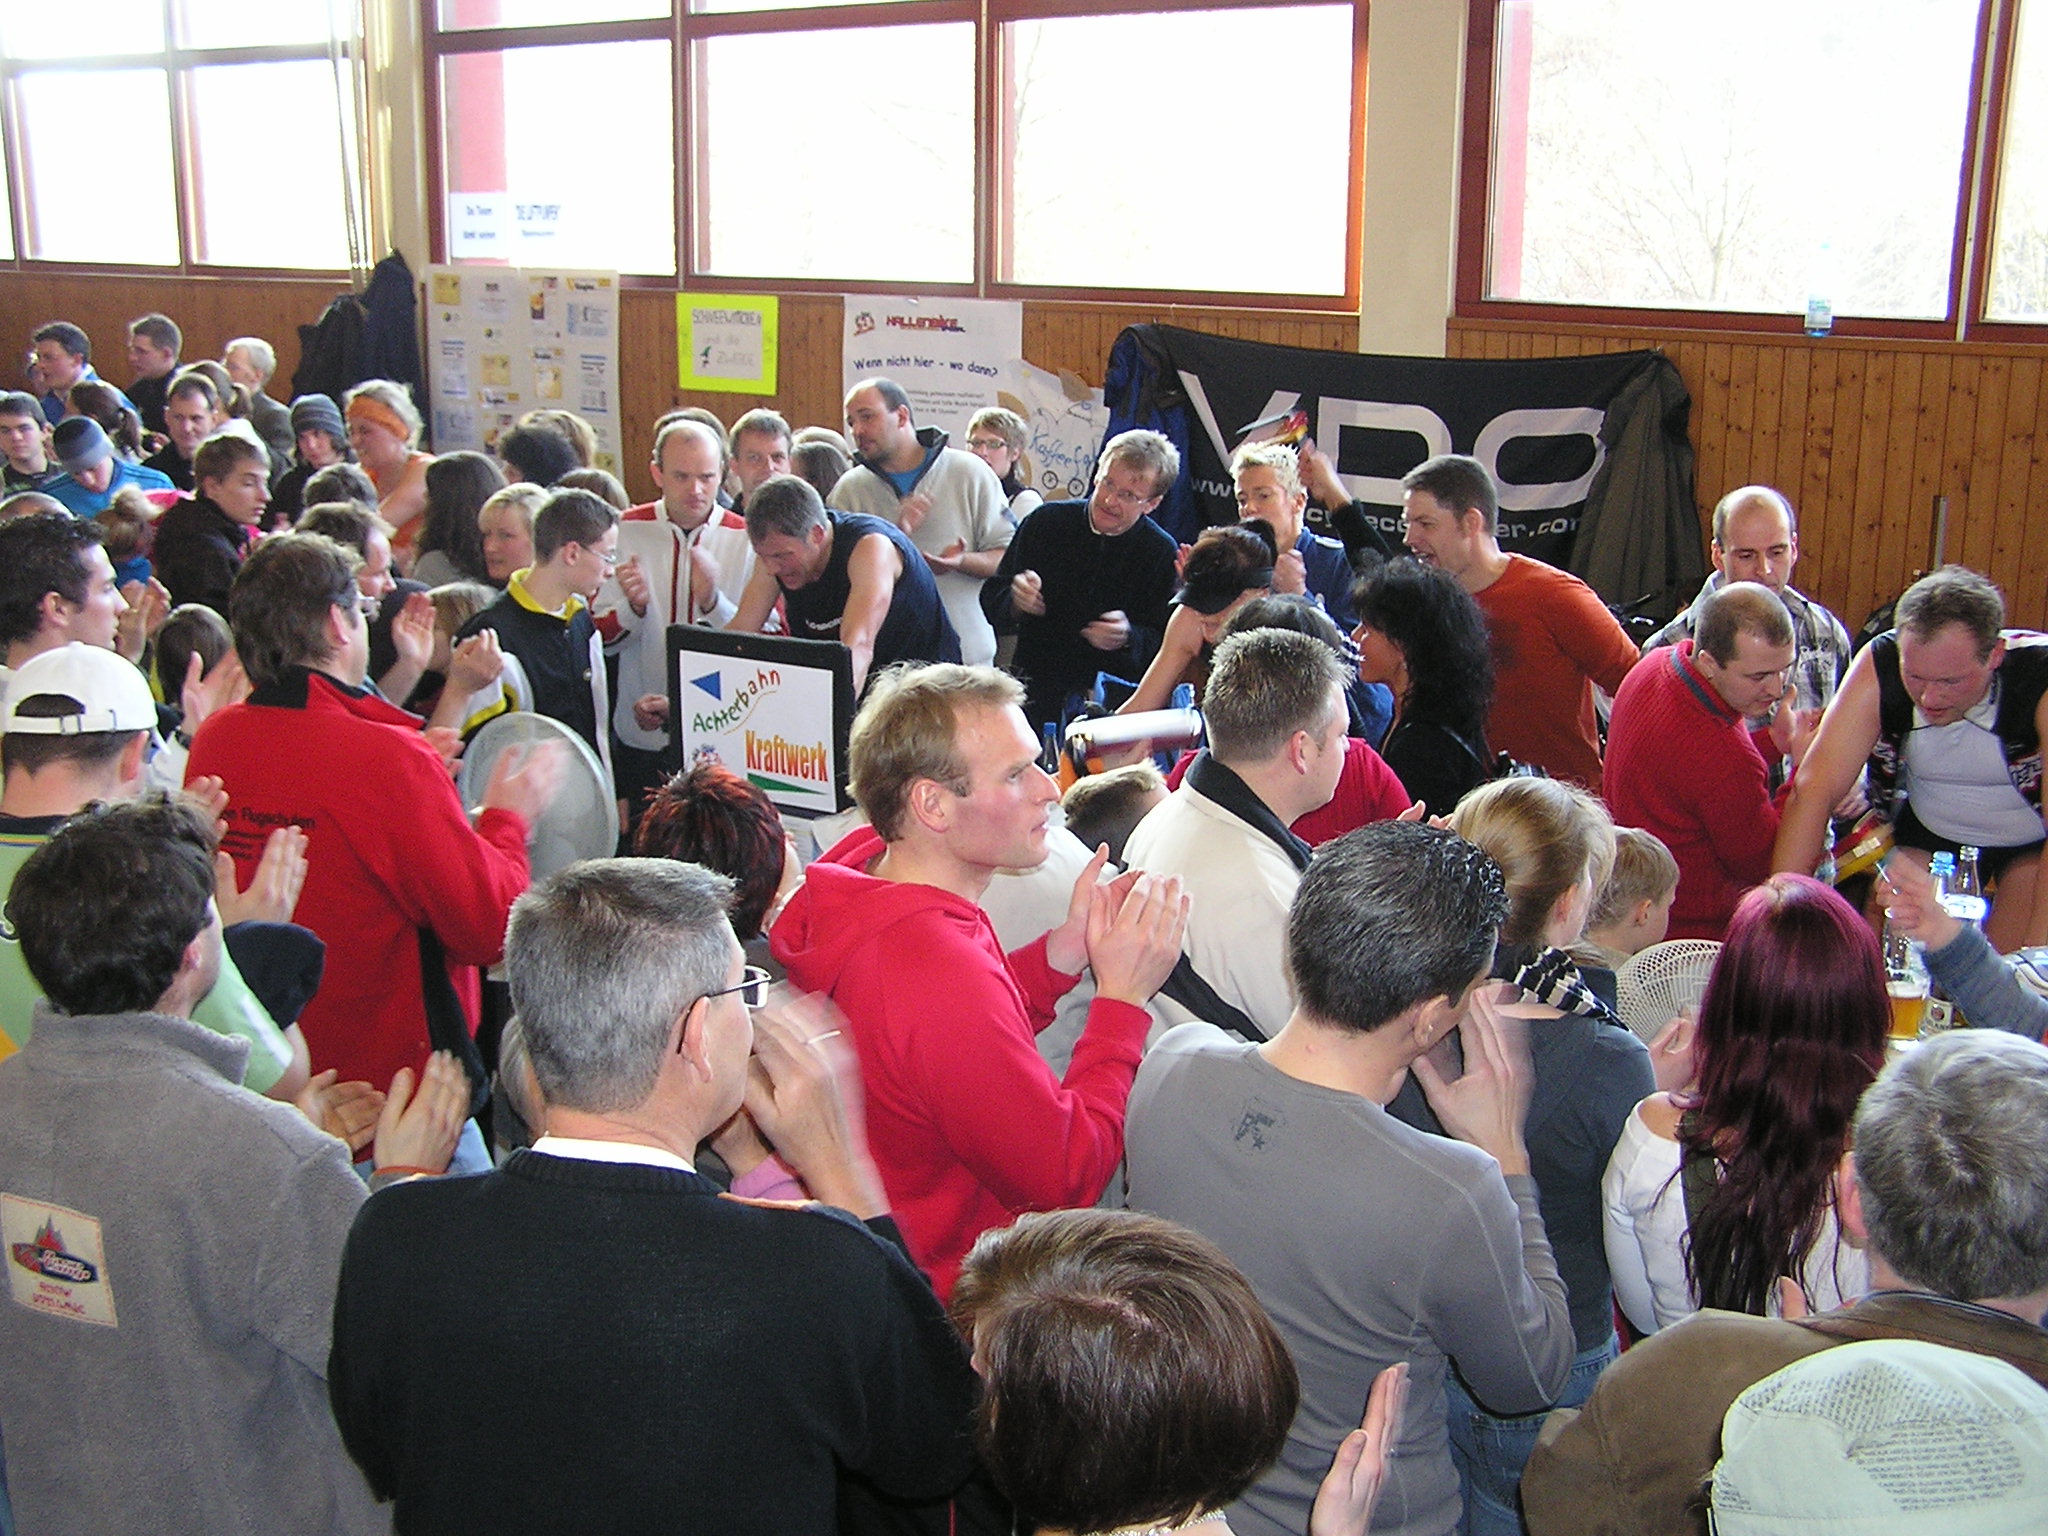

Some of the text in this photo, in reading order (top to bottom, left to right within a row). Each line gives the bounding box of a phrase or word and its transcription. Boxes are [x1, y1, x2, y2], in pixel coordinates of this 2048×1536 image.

[853, 357, 883, 371] Wenn
[886, 355, 911, 368] nicht
[914, 355, 935, 369] hier
[949, 361, 964, 371] wo
[967, 361, 999, 378] dann?
[1176, 369, 1606, 511] VDO
[693, 668, 781, 733] Achterbahn
[744, 729, 829, 783] Kraftwerk
